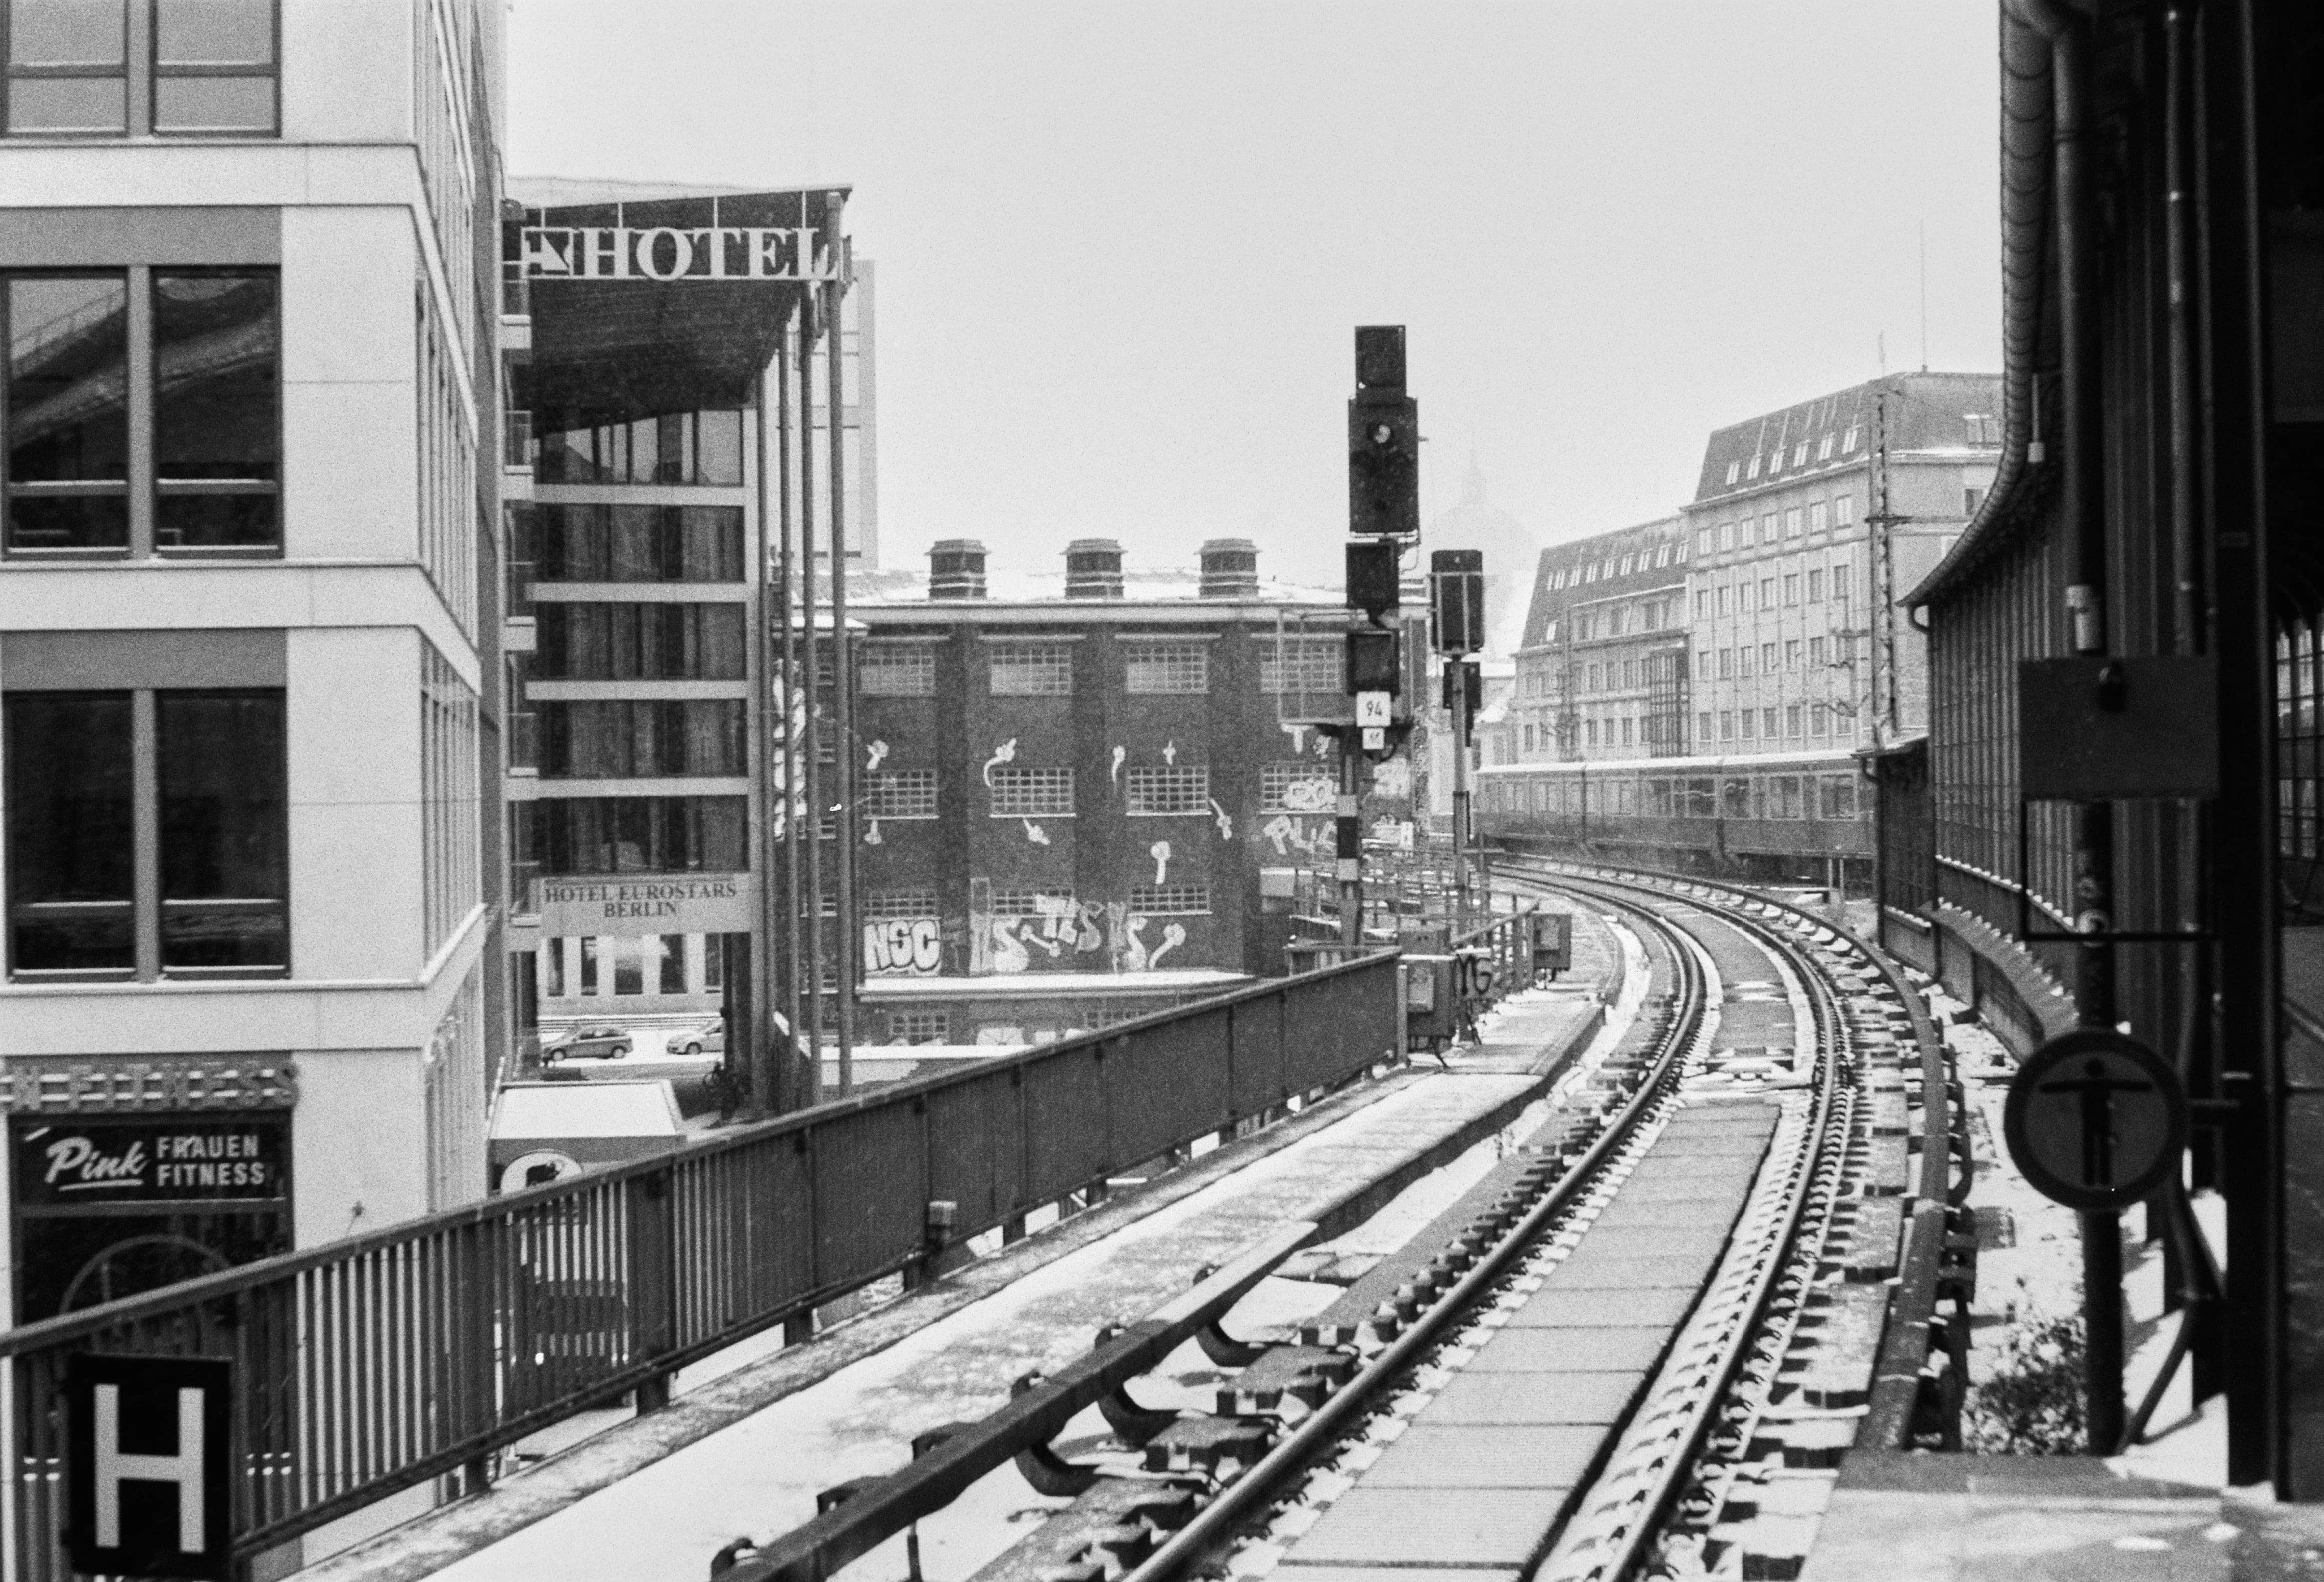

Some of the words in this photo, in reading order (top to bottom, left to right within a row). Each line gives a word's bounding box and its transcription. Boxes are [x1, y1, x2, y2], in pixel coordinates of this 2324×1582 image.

[574, 226, 845, 282] HOTEL
[544, 886, 613, 902] HOTEL
[618, 883, 737, 901] EUROSTARS
[603, 901, 677, 918] BERLIN
[863, 919, 941, 972] NSC
[45, 1136, 151, 1184] Pink
[156, 1135, 259, 1159] FRAUEN
[157, 1162, 265, 1187] FITNESS
[94, 1383, 206, 1554] H
